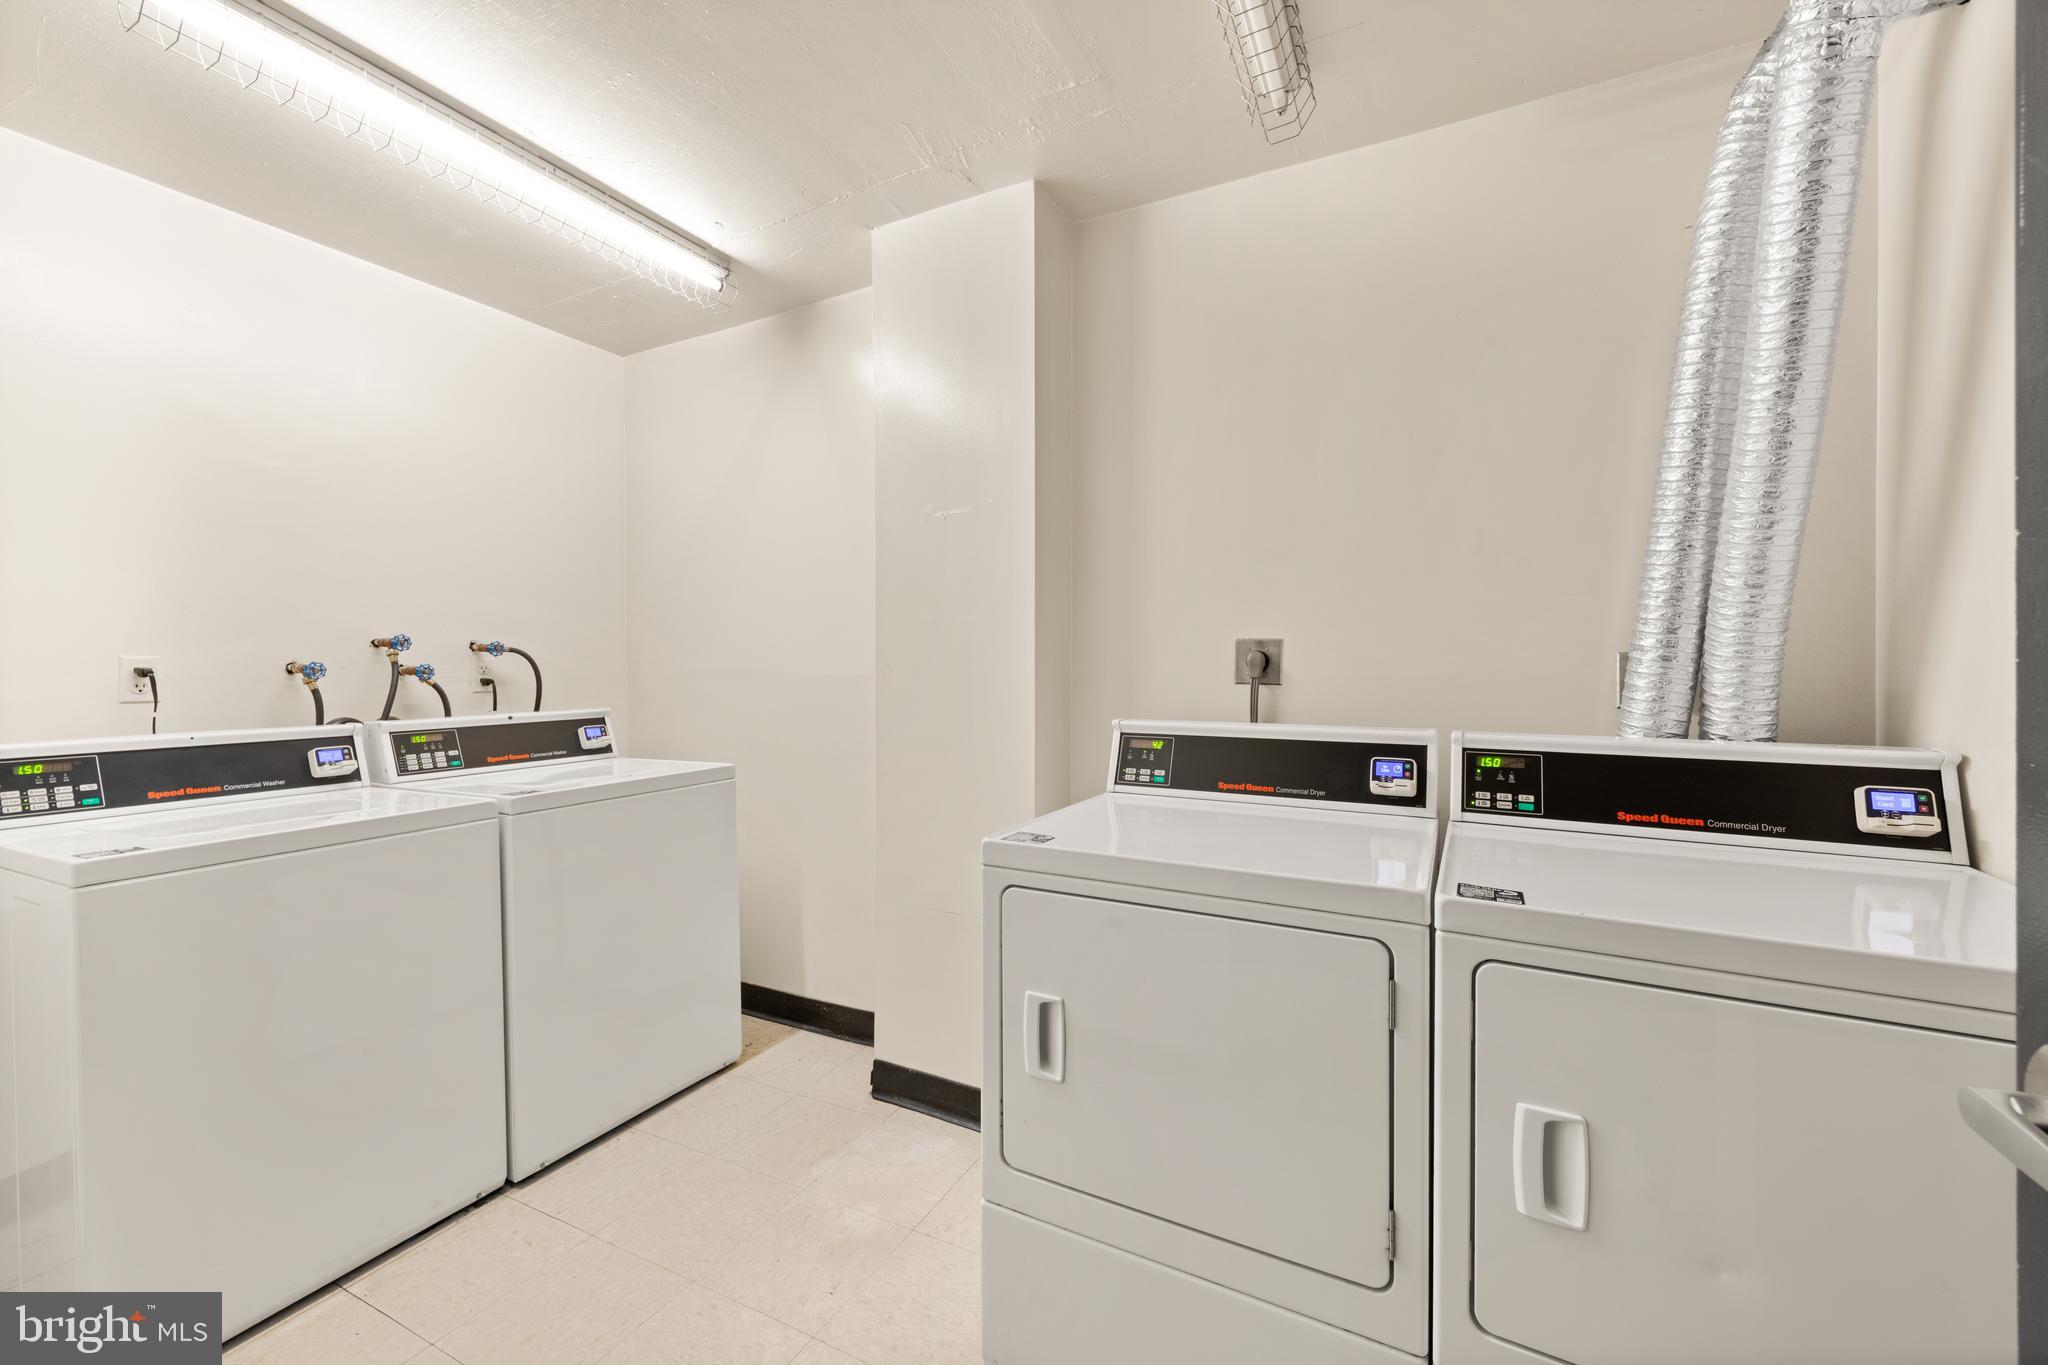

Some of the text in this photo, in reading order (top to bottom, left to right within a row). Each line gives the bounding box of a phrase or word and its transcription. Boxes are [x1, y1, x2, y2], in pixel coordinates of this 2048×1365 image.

[1152, 740, 1164, 750] 42
[487, 754, 508, 763] Speed
[147, 779, 286, 799] Speed Queen Commercial Washer
[1217, 781, 1326, 798] Speed Queen Commercial Dryer
[1616, 811, 1787, 834] Speed Queen Commercial Dryer
